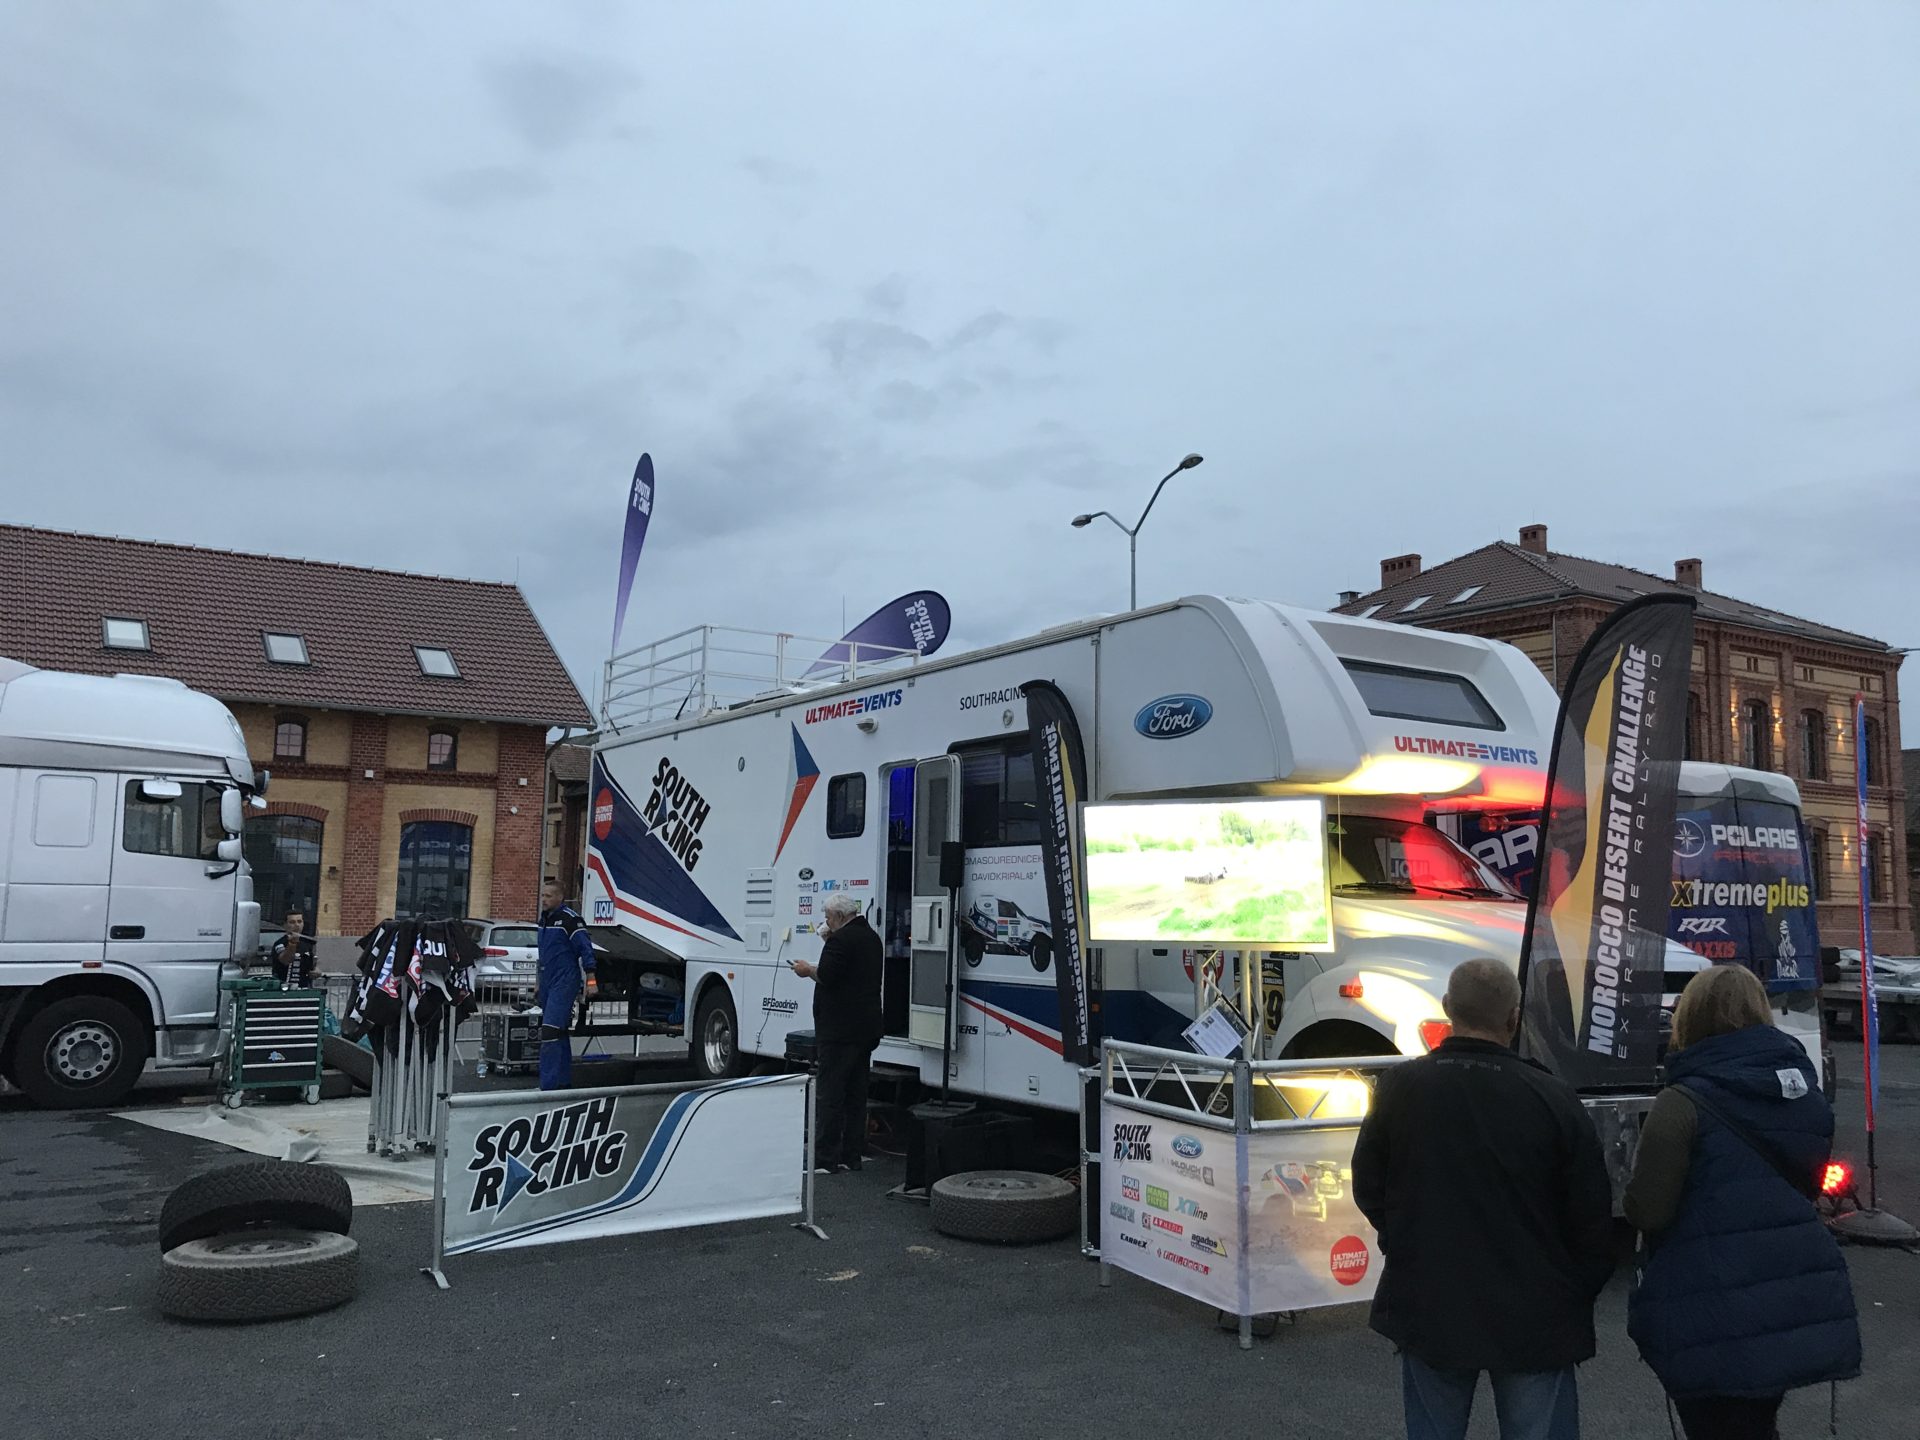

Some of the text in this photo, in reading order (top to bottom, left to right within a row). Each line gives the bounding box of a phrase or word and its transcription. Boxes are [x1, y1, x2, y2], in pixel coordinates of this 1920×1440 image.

[914, 599, 936, 641] SOUTH
[1149, 701, 1196, 733] Ford
[1633, 653, 1662, 855] RALLY-RAID
[652, 757, 711, 835] SOUTH
[1710, 824, 1798, 850] POLARIS
[1587, 643, 1647, 1056] MOROCCO DESERT CHALLENGE
[595, 901, 614, 919] LIQUI
[1677, 917, 1731, 936] RZR
[762, 997, 799, 1010] BFGoodrich
[1262, 989, 1284, 1032] 9
[468, 1096, 619, 1171] SOUTH
[1113, 1123, 1152, 1143] SOUTH
[1176, 1137, 1198, 1155] Ford
[1122, 1176, 1140, 1190] LIQUI
[1122, 1187, 1140, 1201] MOLY
[1331, 1257, 1366, 1270] EVENTS
[1333, 1250, 1368, 1262] ULTIMATE
